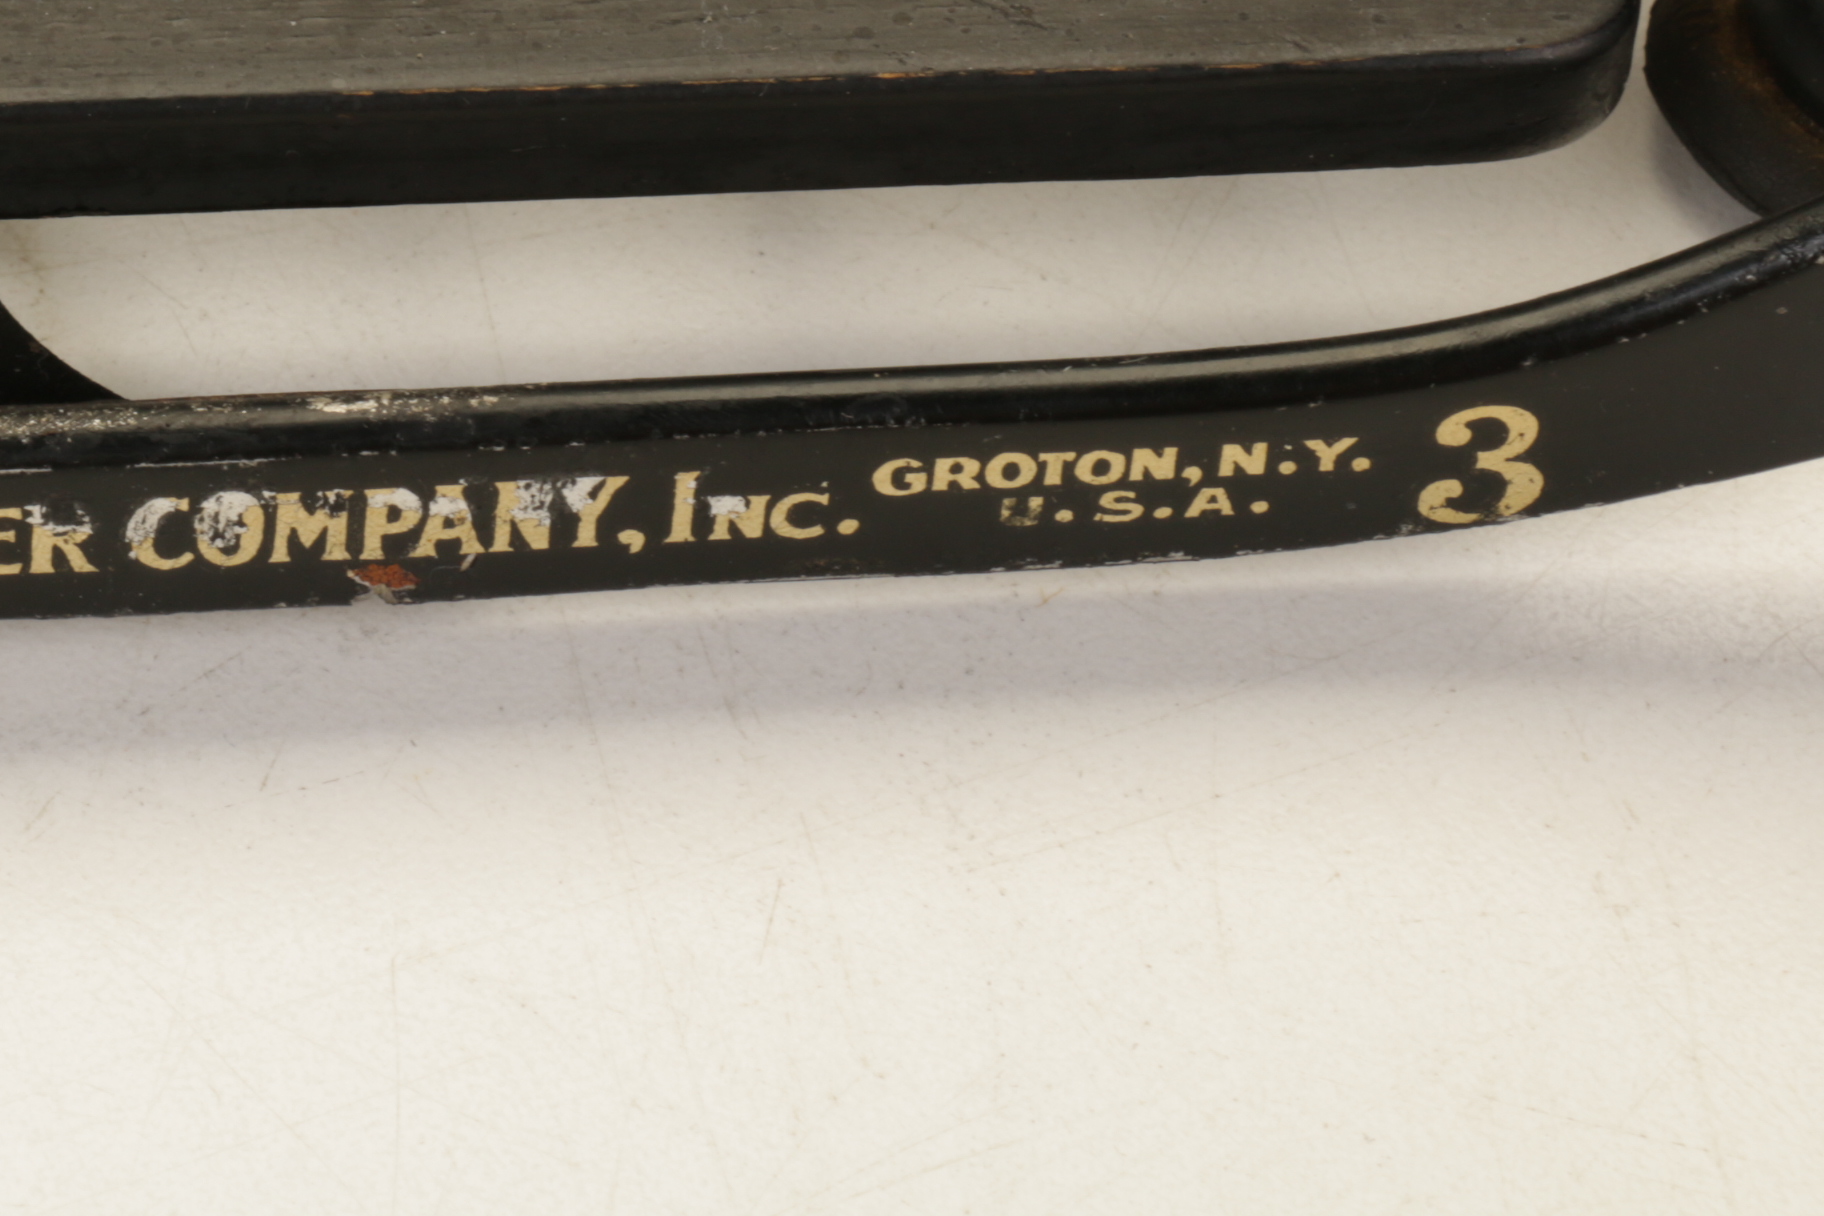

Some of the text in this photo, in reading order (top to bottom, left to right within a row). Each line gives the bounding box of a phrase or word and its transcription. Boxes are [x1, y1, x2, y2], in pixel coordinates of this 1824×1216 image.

[872, 446, 1202, 497] GROTON,
[1417, 404, 1544, 524] 3
[125, 475, 647, 571] COMPANY,
[1000, 486, 1271, 527] U.S.A.
